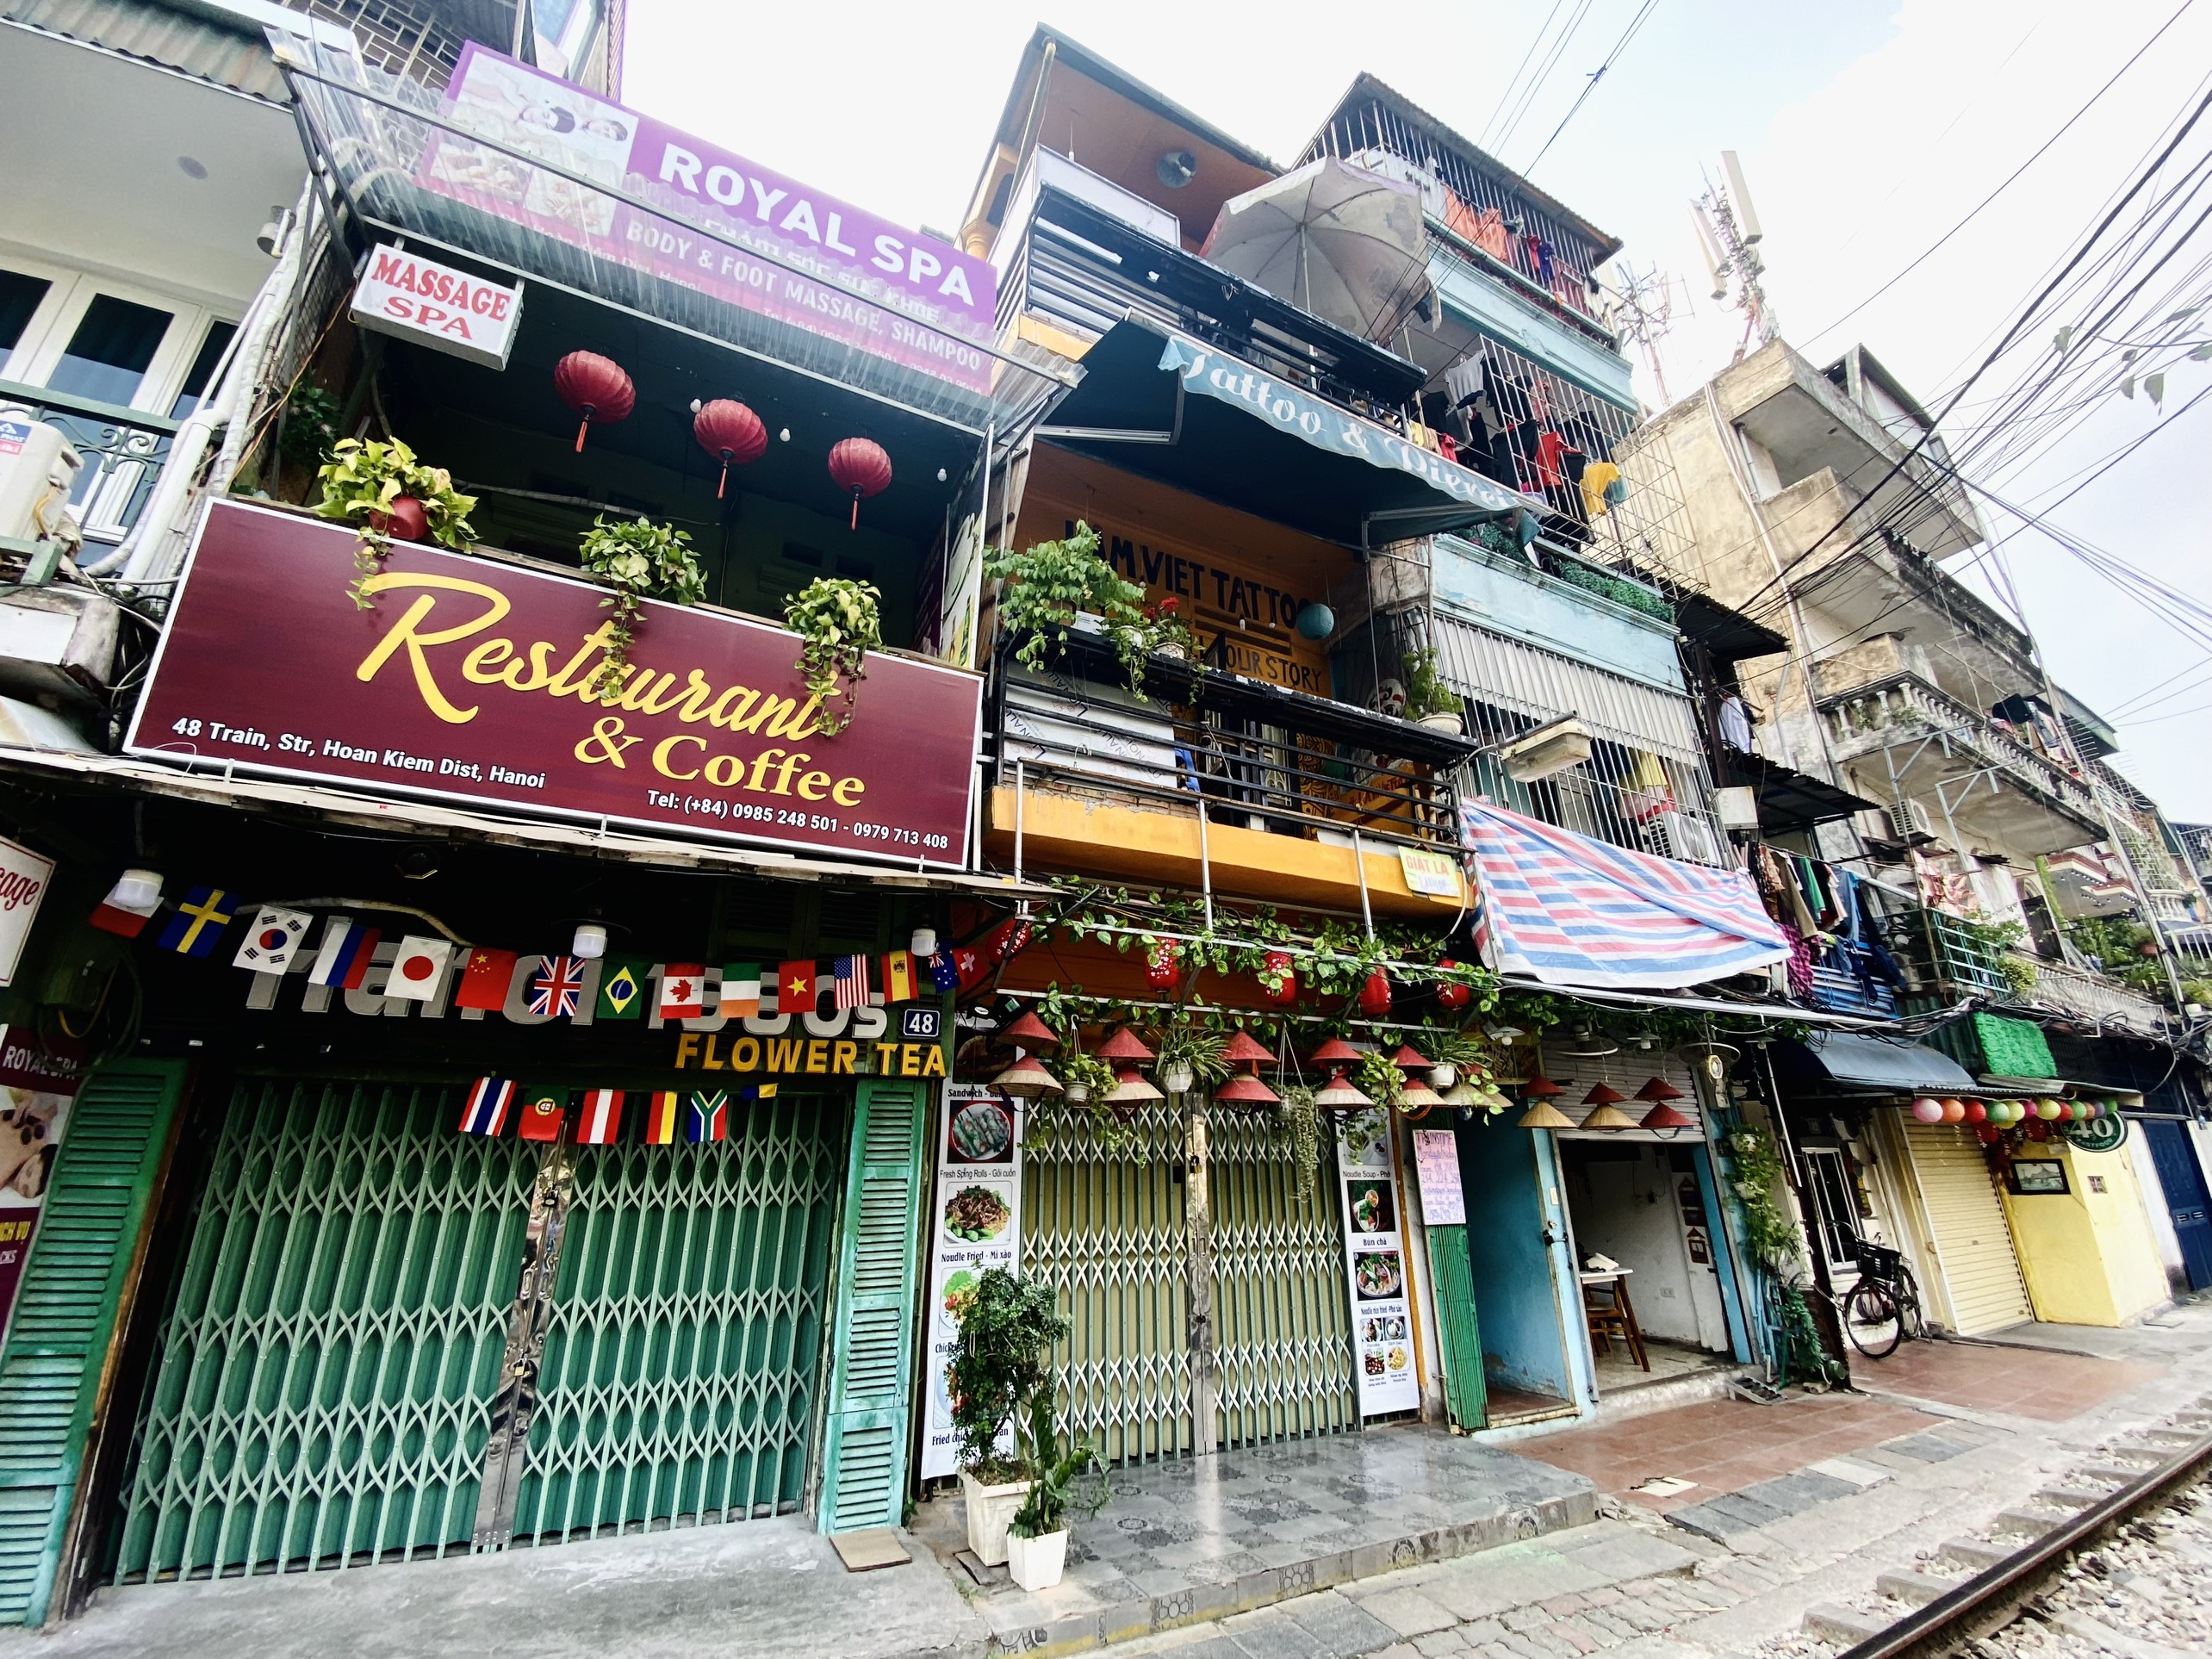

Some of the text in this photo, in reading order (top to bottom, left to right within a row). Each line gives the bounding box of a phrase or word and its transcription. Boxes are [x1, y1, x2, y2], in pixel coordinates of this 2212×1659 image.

[659, 142, 974, 307] ROYAL SPA
[371, 253, 511, 322] MASSAGE
[626, 219, 693, 259] BODY
[698, 251, 715, 269] &
[721, 256, 777, 293] FOOT
[891, 320, 981, 370] SHAMPOO
[384, 296, 473, 339] SPA
[1343, 423, 1370, 454] &
[1140, 544, 1205, 600] VIET
[357, 572, 842, 742] Restaurant
[1264, 656, 1323, 693] STORY
[172, 717, 546, 790] 48 Train, Str, Hoan Kiem Dist, Hanoi
[574, 717, 866, 807] & Coffee
[648, 790, 680, 810] Tel:
[684, 795, 729, 821] (+84)
[732, 804, 774, 823] 0985
[776, 810, 807, 828] 248
[811, 814, 839, 833] 501
[853, 822, 891, 842] 0979
[893, 828, 921, 846] 713
[923, 833, 949, 849] 408
[910, 1012, 933, 1034] 48
[674, 1033, 947, 1077] FLOWER TEA
[2068, 1119, 2114, 1139] 40
[966, 1251, 984, 1261] Fried
[932, 1434, 950, 1445] Fried
